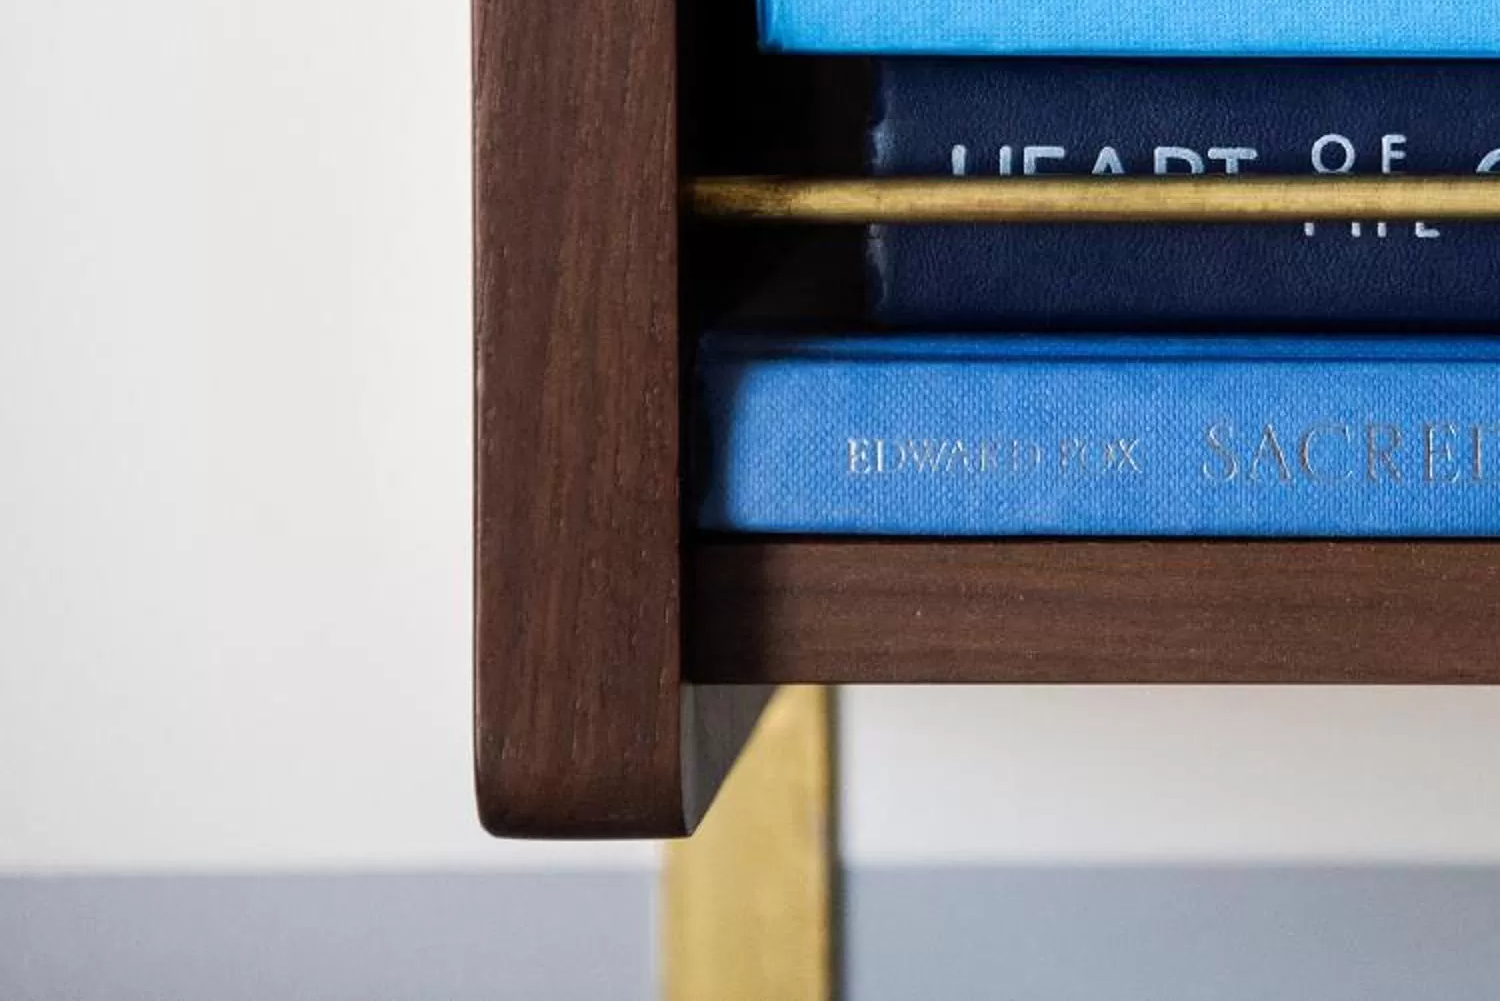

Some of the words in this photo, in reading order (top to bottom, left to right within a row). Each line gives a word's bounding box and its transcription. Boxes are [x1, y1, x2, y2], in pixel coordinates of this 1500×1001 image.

[1311, 134, 1407, 174] OF
[847, 439, 1041, 473] EDWARD
[1060, 438, 1141, 473] FOX
